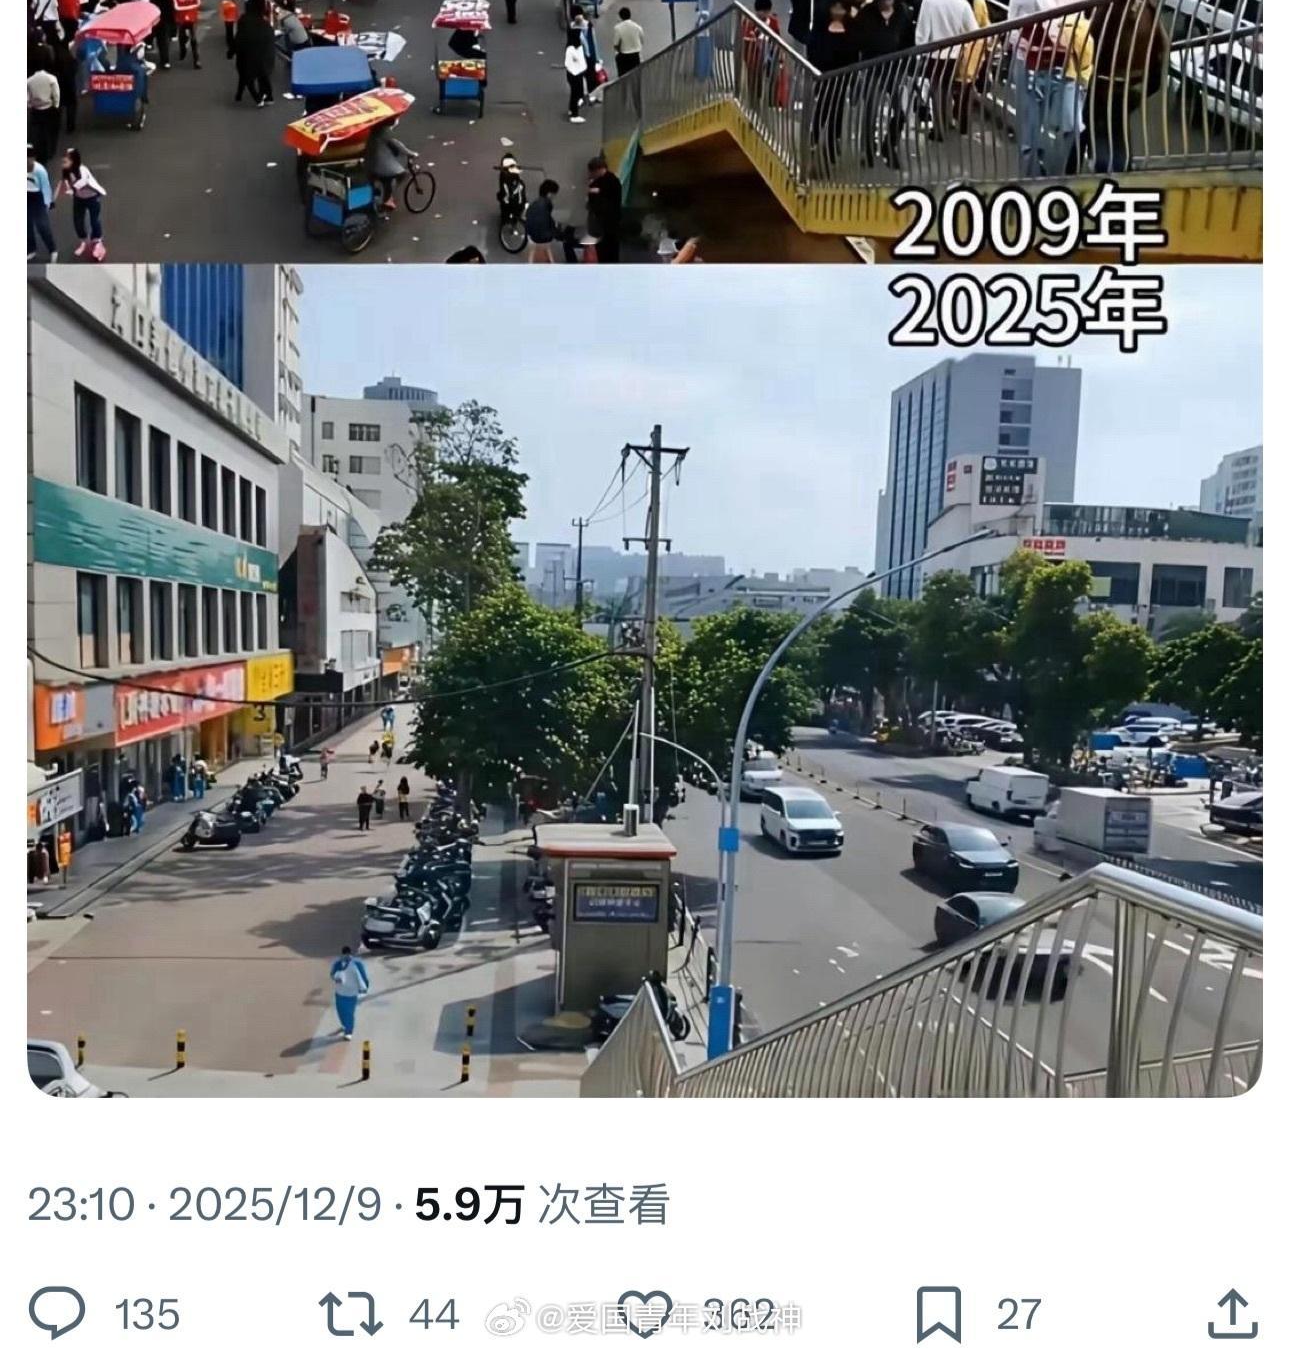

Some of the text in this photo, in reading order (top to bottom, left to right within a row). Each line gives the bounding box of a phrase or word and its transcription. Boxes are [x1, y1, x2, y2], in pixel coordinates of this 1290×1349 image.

[29, 1187, 134, 1221] 23:10
[170, 1185, 381, 1225] 2025/12/9
[416, 1185, 525, 1225] 5.9万
[539, 1183, 670, 1225] 次查看
[116, 1298, 179, 1330] 135
[409, 1299, 459, 1329] 44
[998, 1298, 1041, 1329] 27
